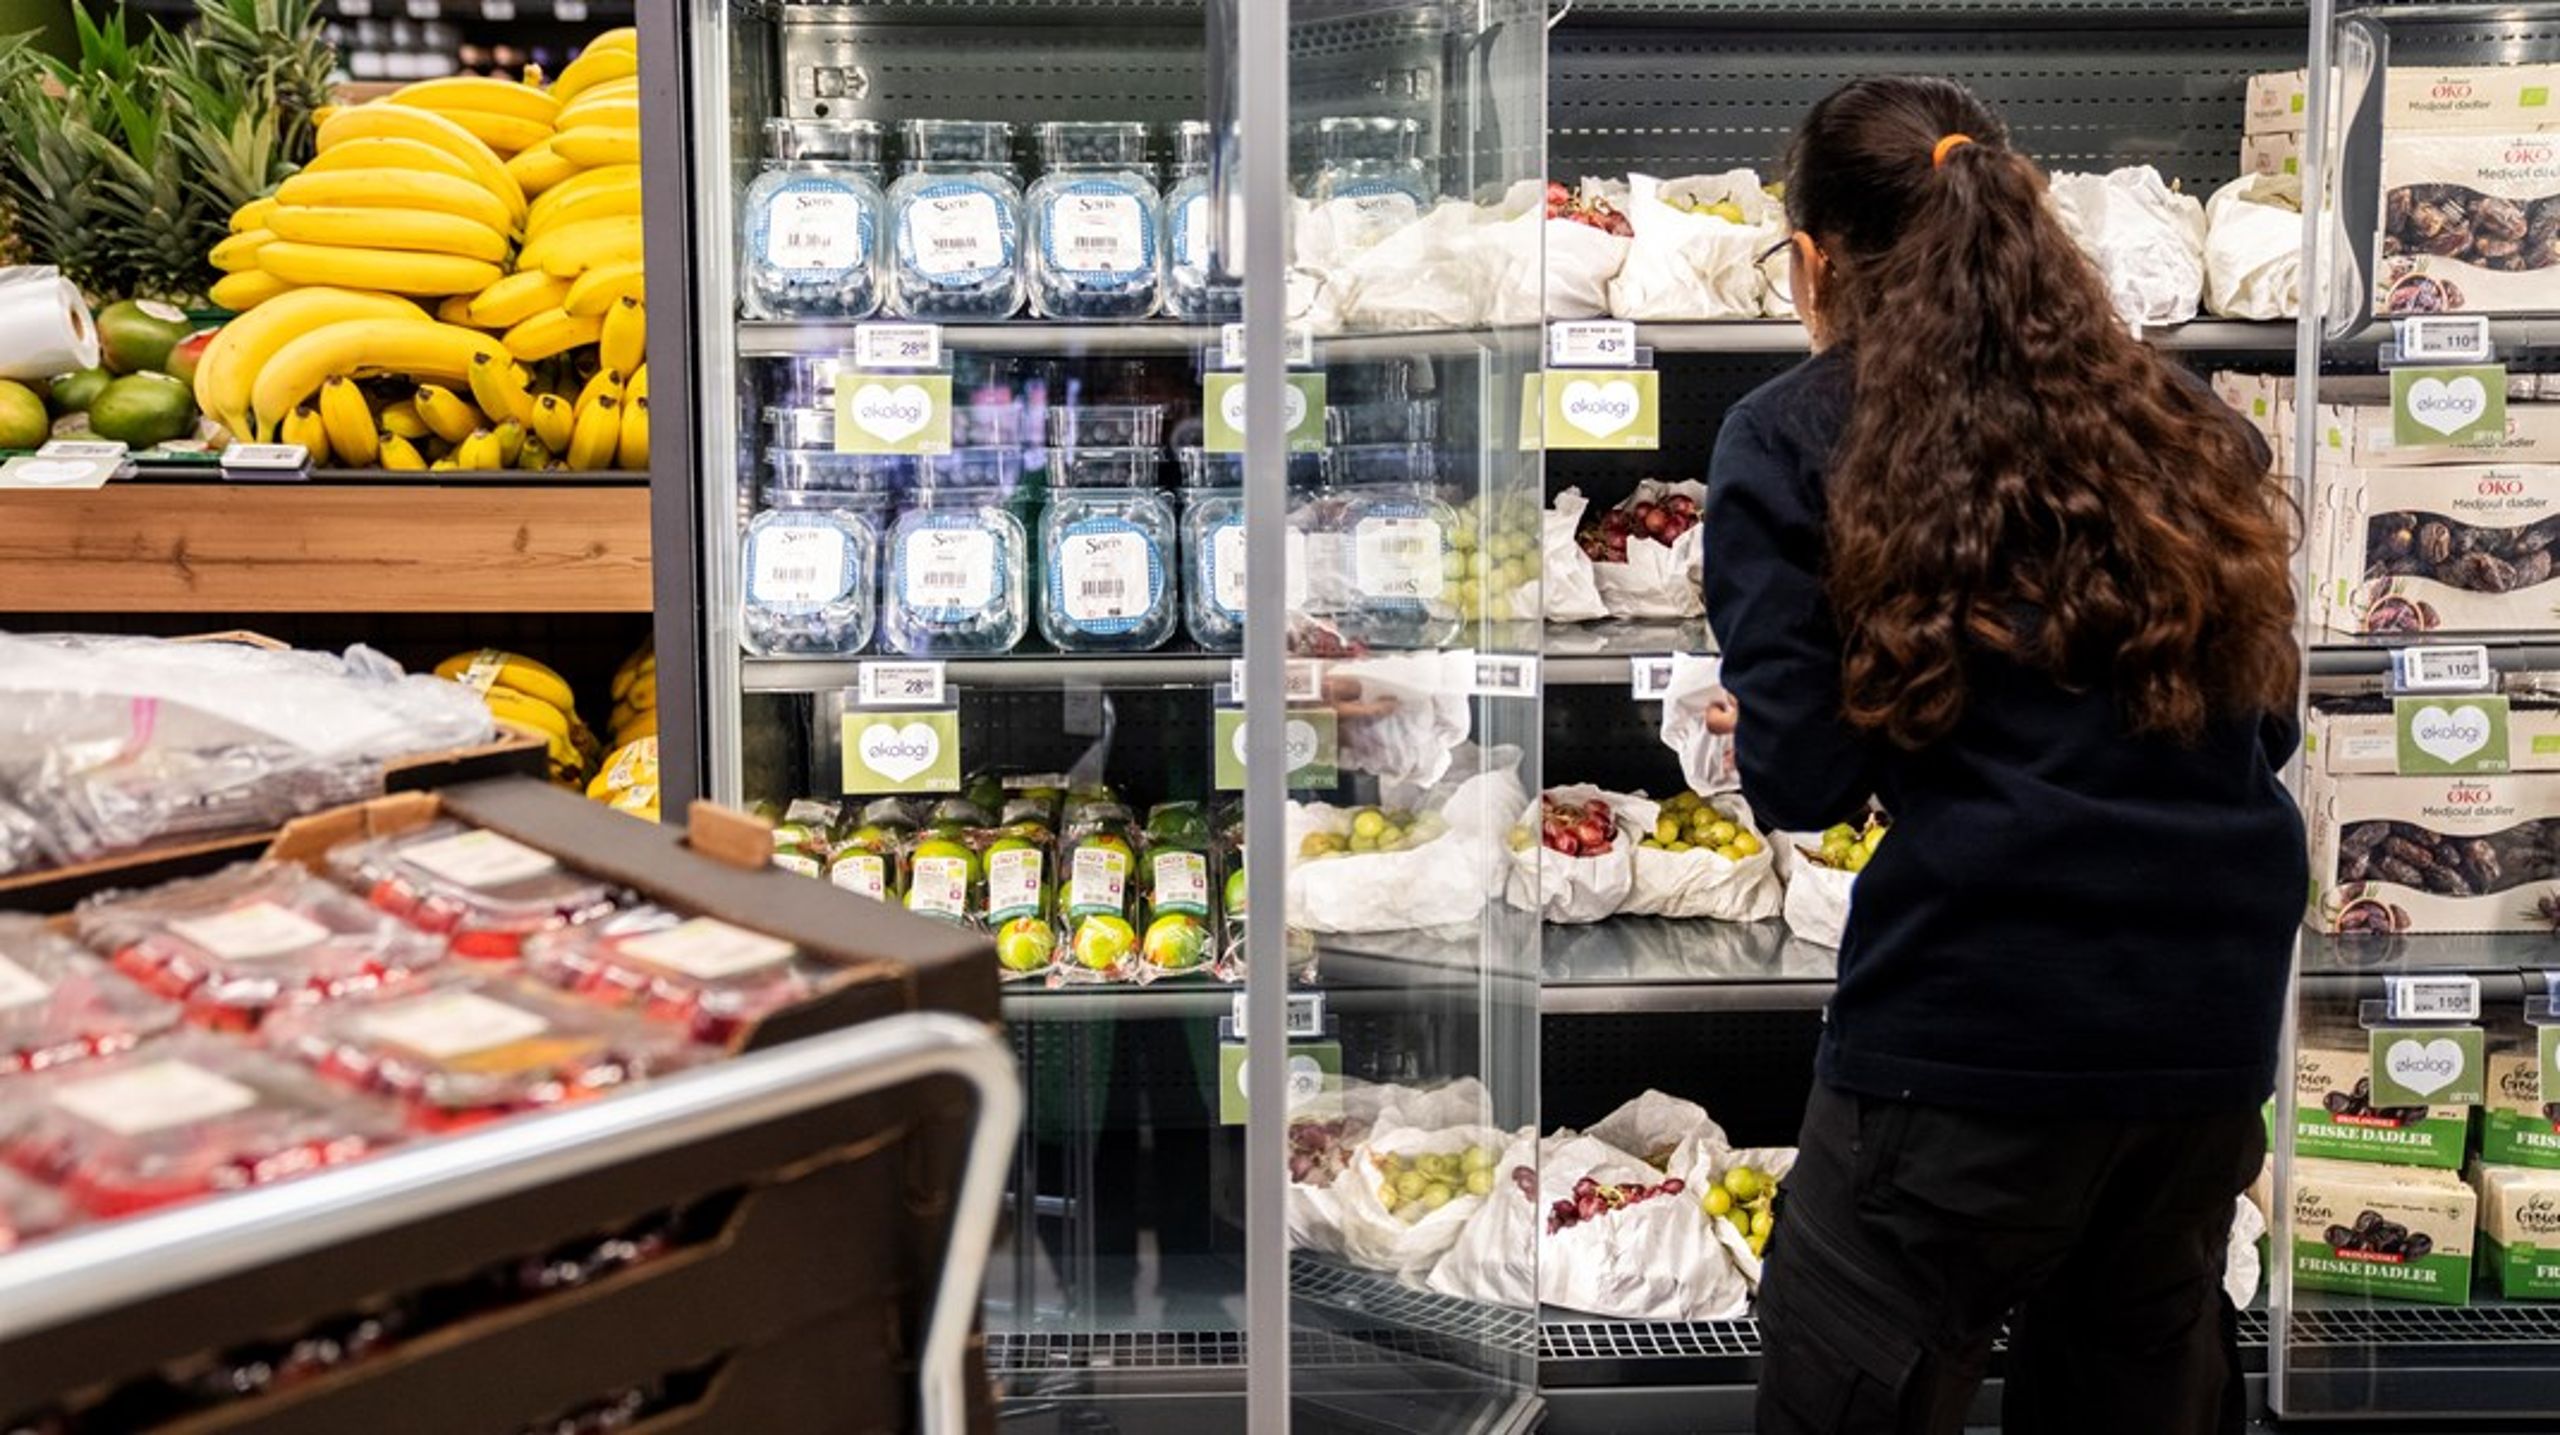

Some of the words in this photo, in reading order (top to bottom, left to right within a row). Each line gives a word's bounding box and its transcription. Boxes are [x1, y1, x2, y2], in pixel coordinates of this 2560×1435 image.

[861, 401, 922, 424] økologi
[1569, 398, 1630, 419] økologi
[2416, 395, 2477, 414] økologi
[2447, 664, 2471, 675] 110
[2420, 722, 2482, 743] økologi
[868, 741, 929, 761] økologi
[2395, 1056, 2455, 1077] økologi
[2297, 1123, 2359, 1141] FRISKE
[2363, 1128, 2433, 1146] DADLER
[2298, 1257, 2362, 1275] FRISKE
[2364, 1263, 2437, 1283] DADLER
